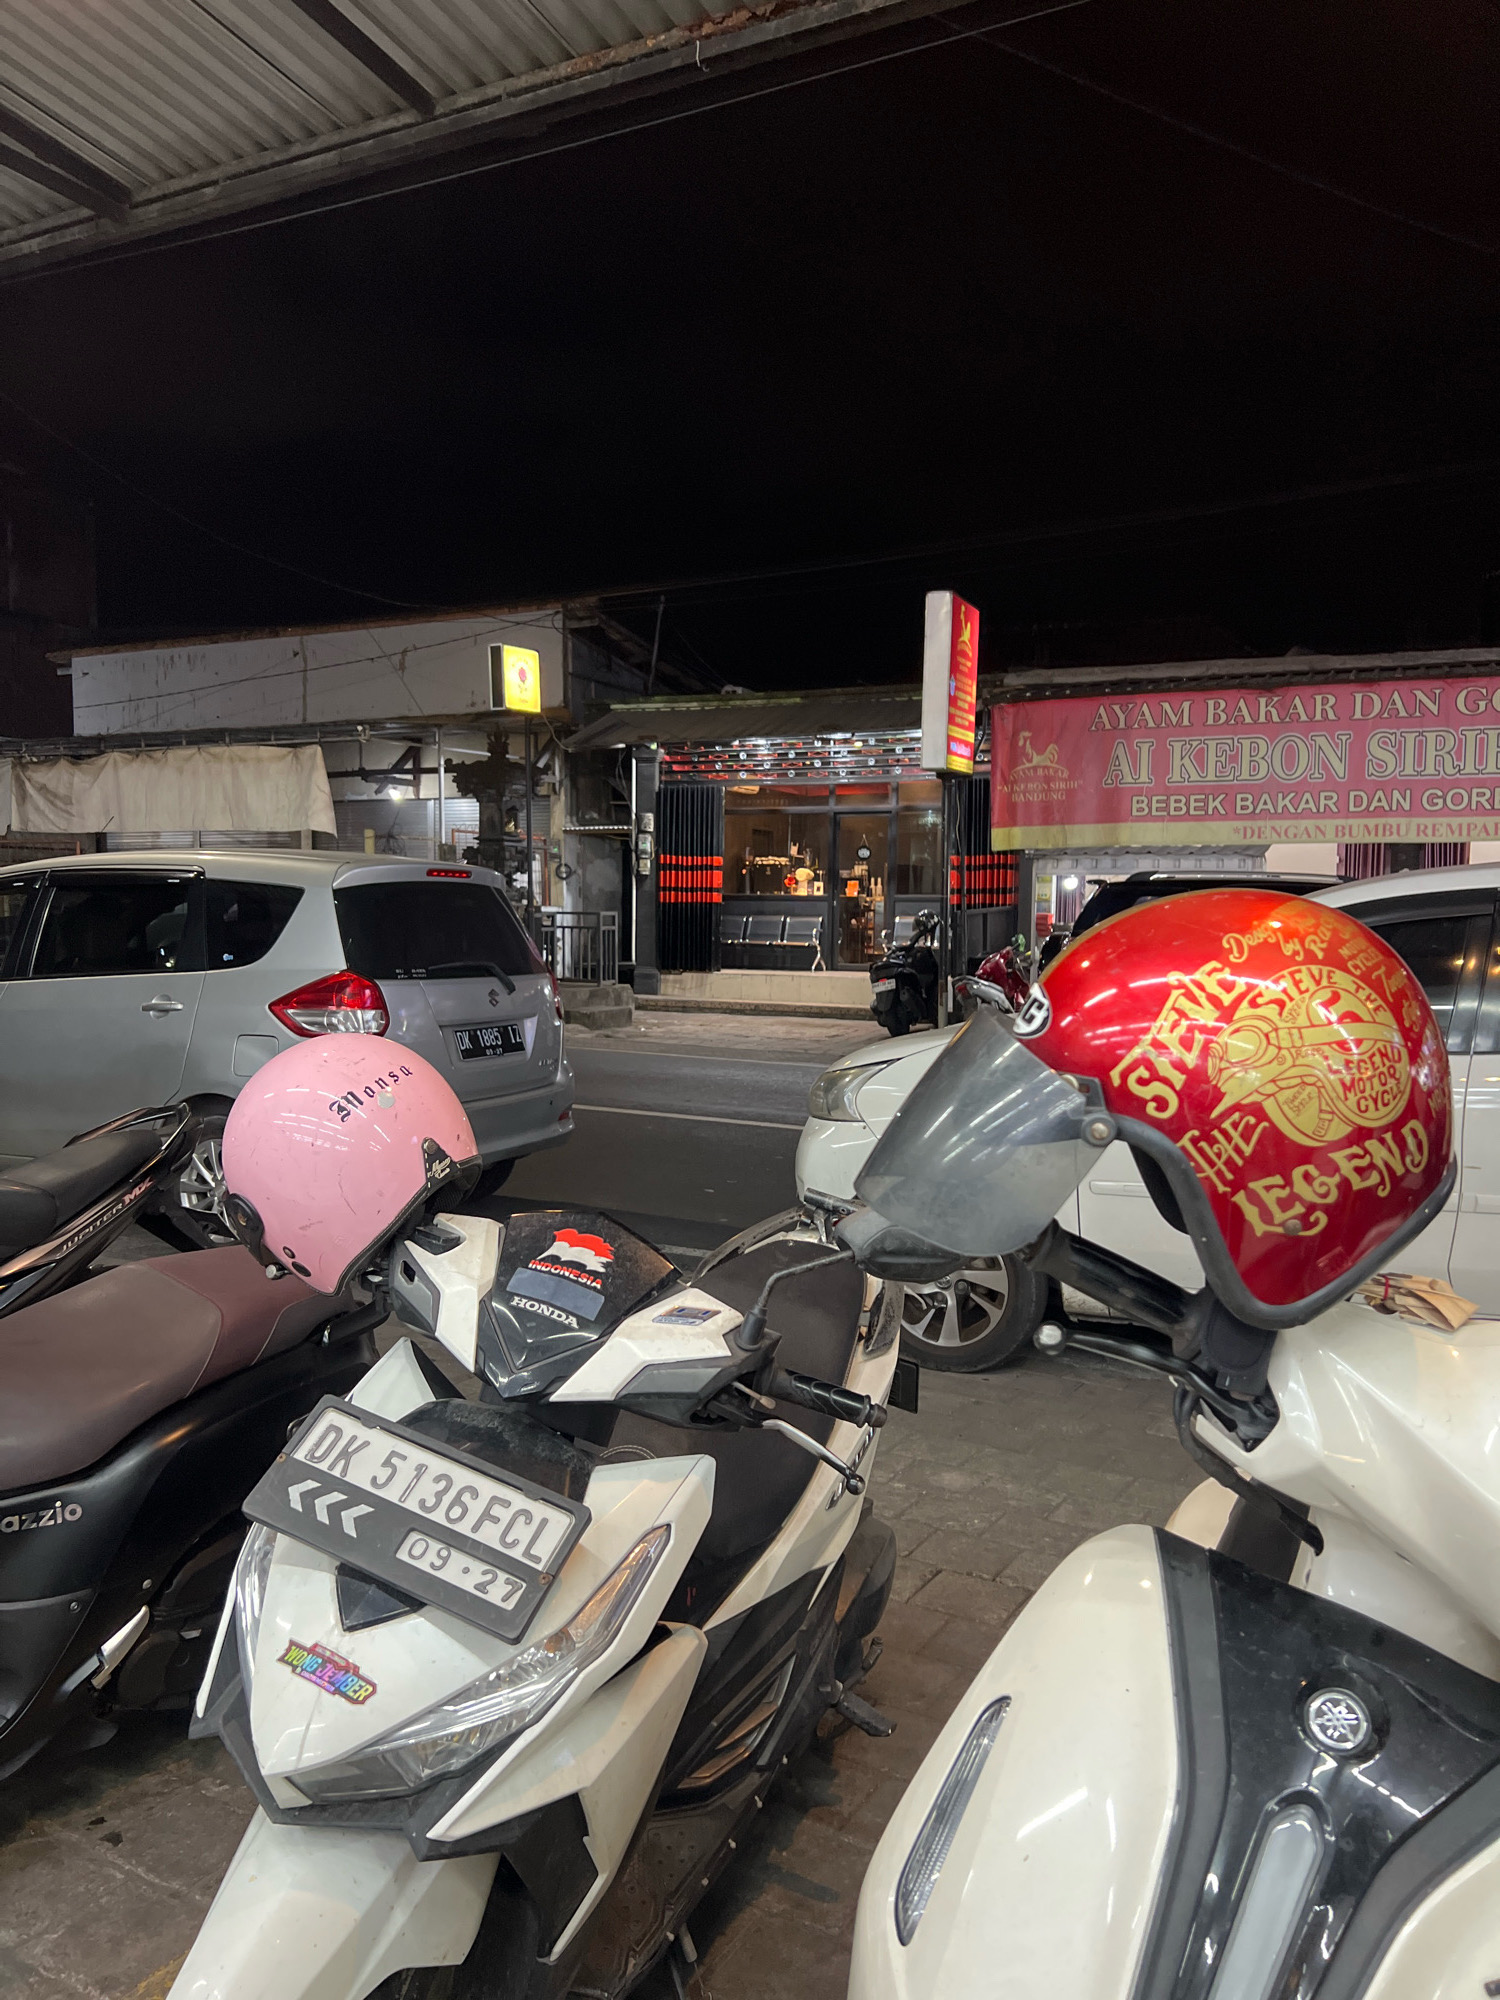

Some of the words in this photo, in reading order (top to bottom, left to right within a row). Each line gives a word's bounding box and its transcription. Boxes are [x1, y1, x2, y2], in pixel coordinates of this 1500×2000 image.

[1088, 699, 1194, 731] AYAM
[1204, 693, 1340, 726] BAKAR
[1349, 687, 1443, 721] DAN
[1455, 686, 1500, 716] G
[1103, 740, 1154, 787] AI
[1166, 731, 1352, 785] KEBON
[1011, 791, 1066, 802] BANDUNG
[1131, 792, 1228, 817] BEBEK
[1235, 790, 1339, 816] BAKAR
[1348, 788, 1412, 813] DAN
[1334, 821, 1410, 839] BUMBU
[1248, 967, 1337, 1018] STEVE
[1351, 979, 1388, 1017] THE
[456, 1031, 473, 1050] DK
[476, 1028, 502, 1047] 1885
[1109, 961, 1247, 1120] STEVE
[1323, 1044, 1402, 1075] LEGEND
[1339, 1064, 1401, 1101] MOTOR
[1176, 1111, 1270, 1194] THE
[1231, 1119, 1429, 1238] LEGEND
[59, 1202, 123, 1255] JUPITER
[528, 1259, 603, 1289] INDONESIA
[510, 1296, 579, 1329] HONDA
[304, 1423, 371, 1479] DK
[284, 1645, 323, 1673] WONG
[315, 1663, 374, 1701] JEMBER
